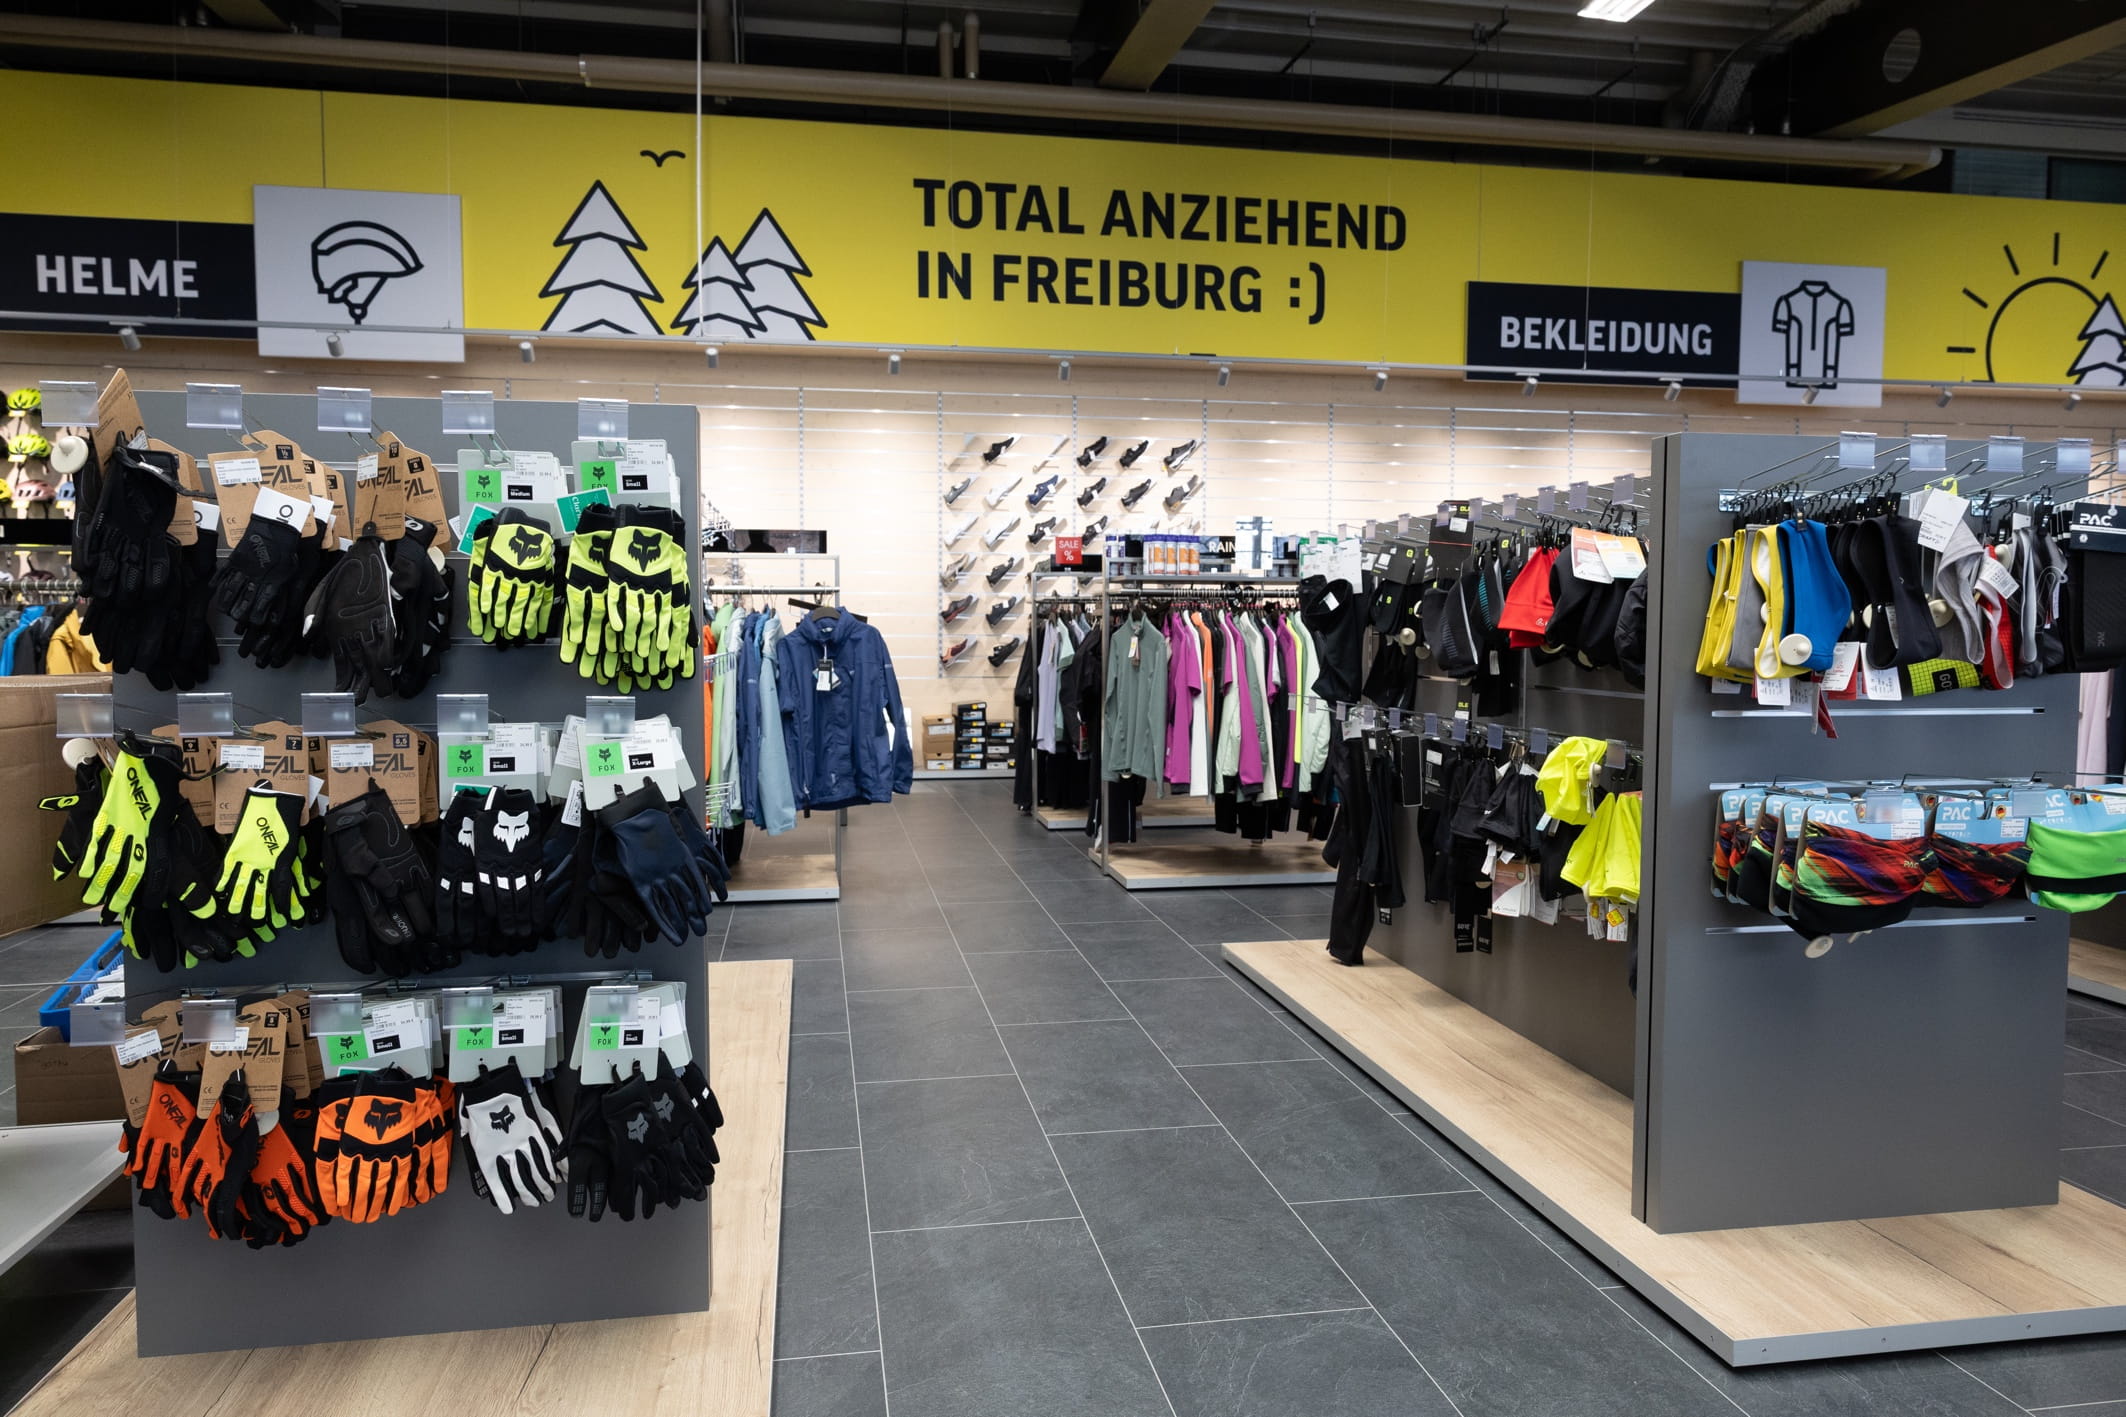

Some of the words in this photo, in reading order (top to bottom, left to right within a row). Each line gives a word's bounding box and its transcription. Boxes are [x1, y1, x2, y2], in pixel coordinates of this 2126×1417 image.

[913, 178, 1085, 235] TOTAL
[1100, 189, 1407, 251] ANZIEHEND
[36, 254, 199, 298] HELME
[917, 250, 971, 301] IN
[993, 254, 1262, 313] FREIBURG
[1500, 315, 1712, 356] BEKLEIDUNG
[2079, 513, 2112, 527] PAC
[1059, 540, 1079, 548] SALE
[598, 764, 615, 772] FOX
[126, 766, 153, 821] ONEAL
[1814, 810, 1849, 825] PAC
[1942, 806, 1971, 821] PAC
[256, 816, 280, 856] ONEAL
[1903, 860, 1920, 869] PAC
[466, 1038, 484, 1046] FOX
[340, 1050, 359, 1060] FOX
[160, 1093, 188, 1129] ONEAL
